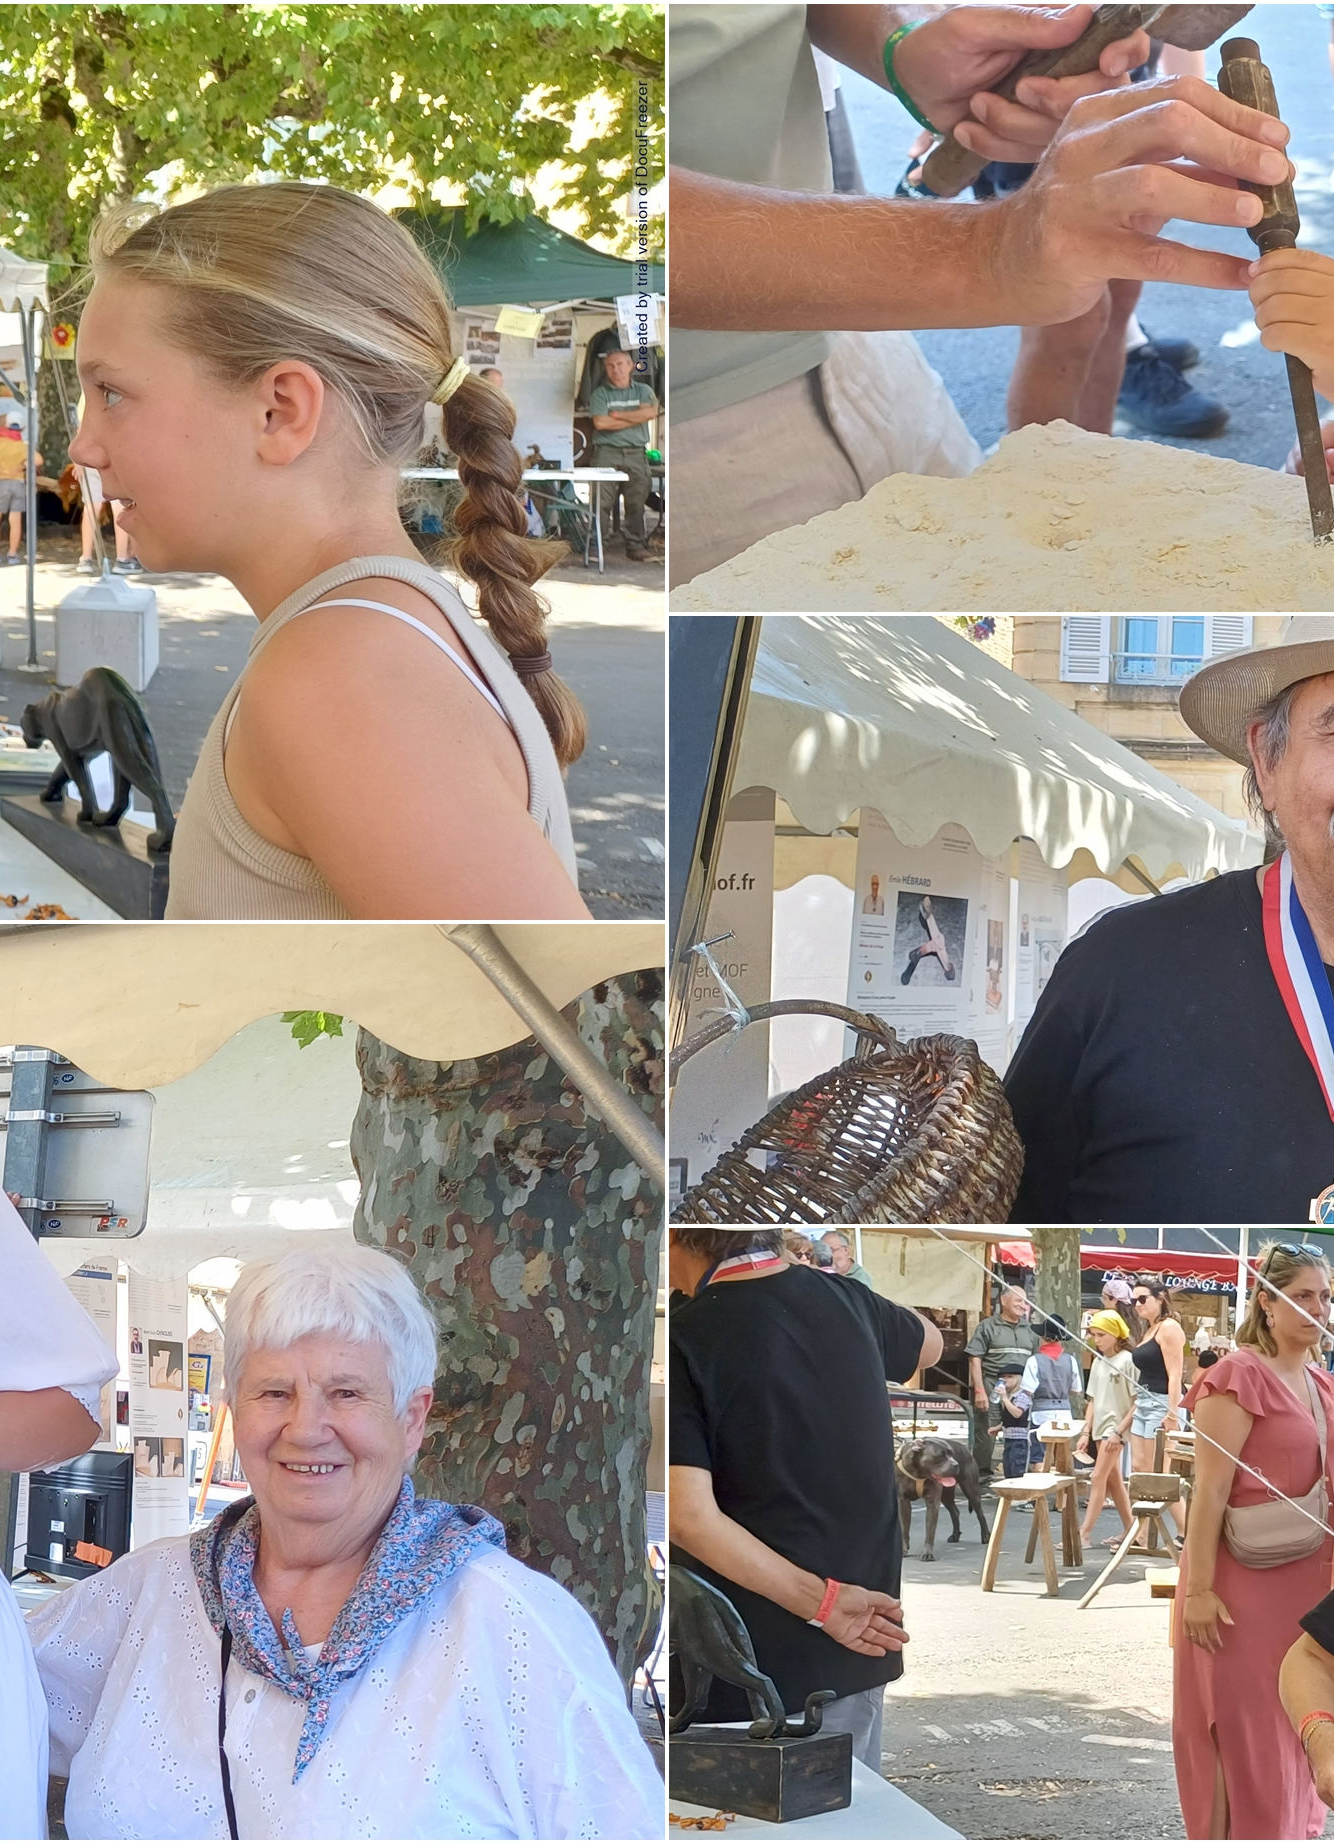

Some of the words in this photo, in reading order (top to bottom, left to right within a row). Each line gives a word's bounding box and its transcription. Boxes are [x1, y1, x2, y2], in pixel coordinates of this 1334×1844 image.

[902, 875, 931, 887] HÉBRARD
[696, 965, 708, 977] et
[100, 1216, 129, 1228] PSR
[1165, 1277, 1218, 1290] LOUNGE
